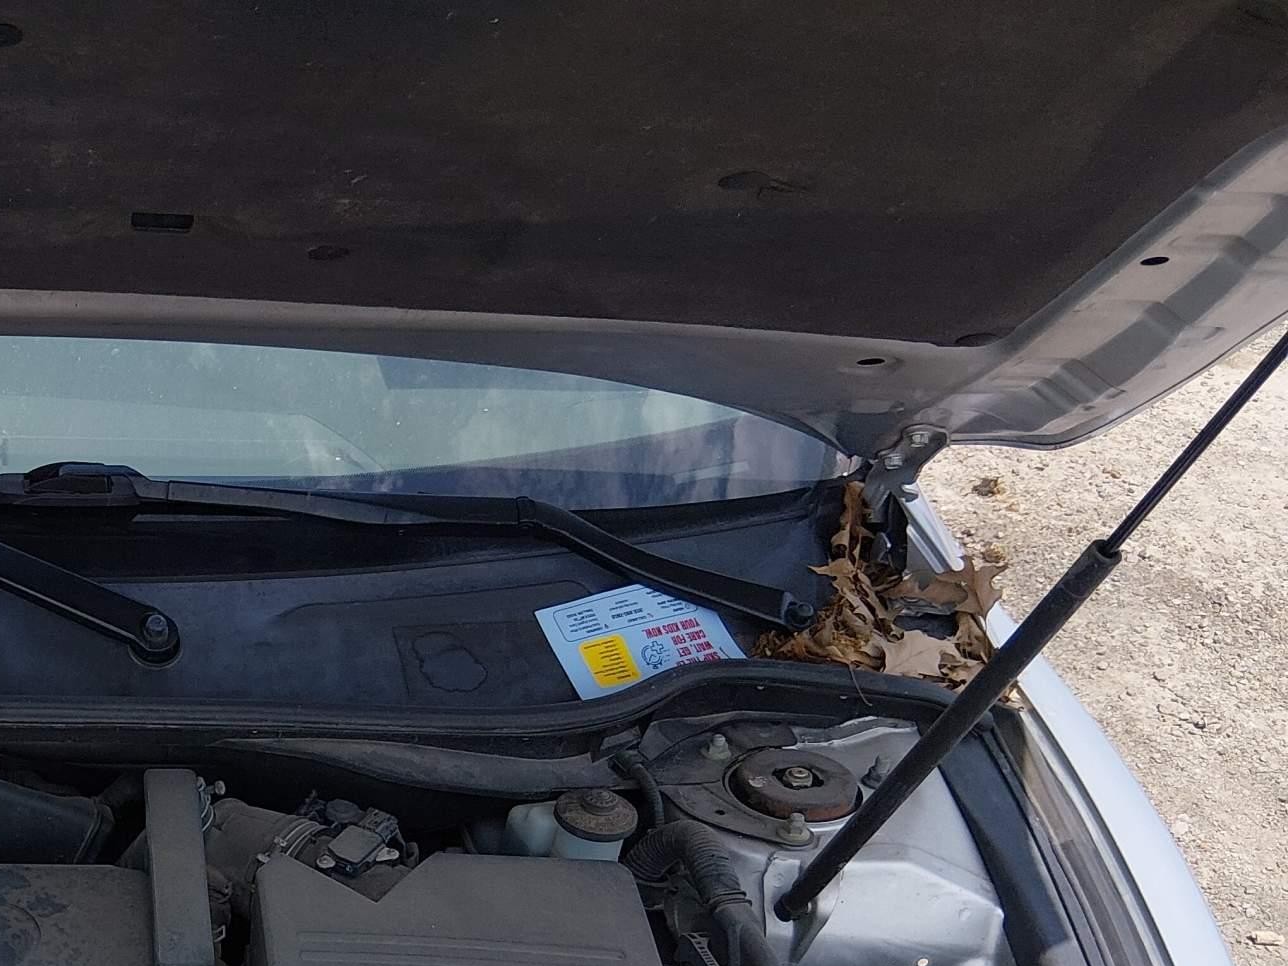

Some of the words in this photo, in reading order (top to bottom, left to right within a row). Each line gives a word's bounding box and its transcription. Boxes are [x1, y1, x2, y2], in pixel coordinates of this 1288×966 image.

[662, 623, 680, 634] KIDS
[679, 618, 700, 630] YOUR
[671, 634, 686, 645] FOR
[686, 630, 706, 642] CARE
[676, 647, 691, 657] GET
